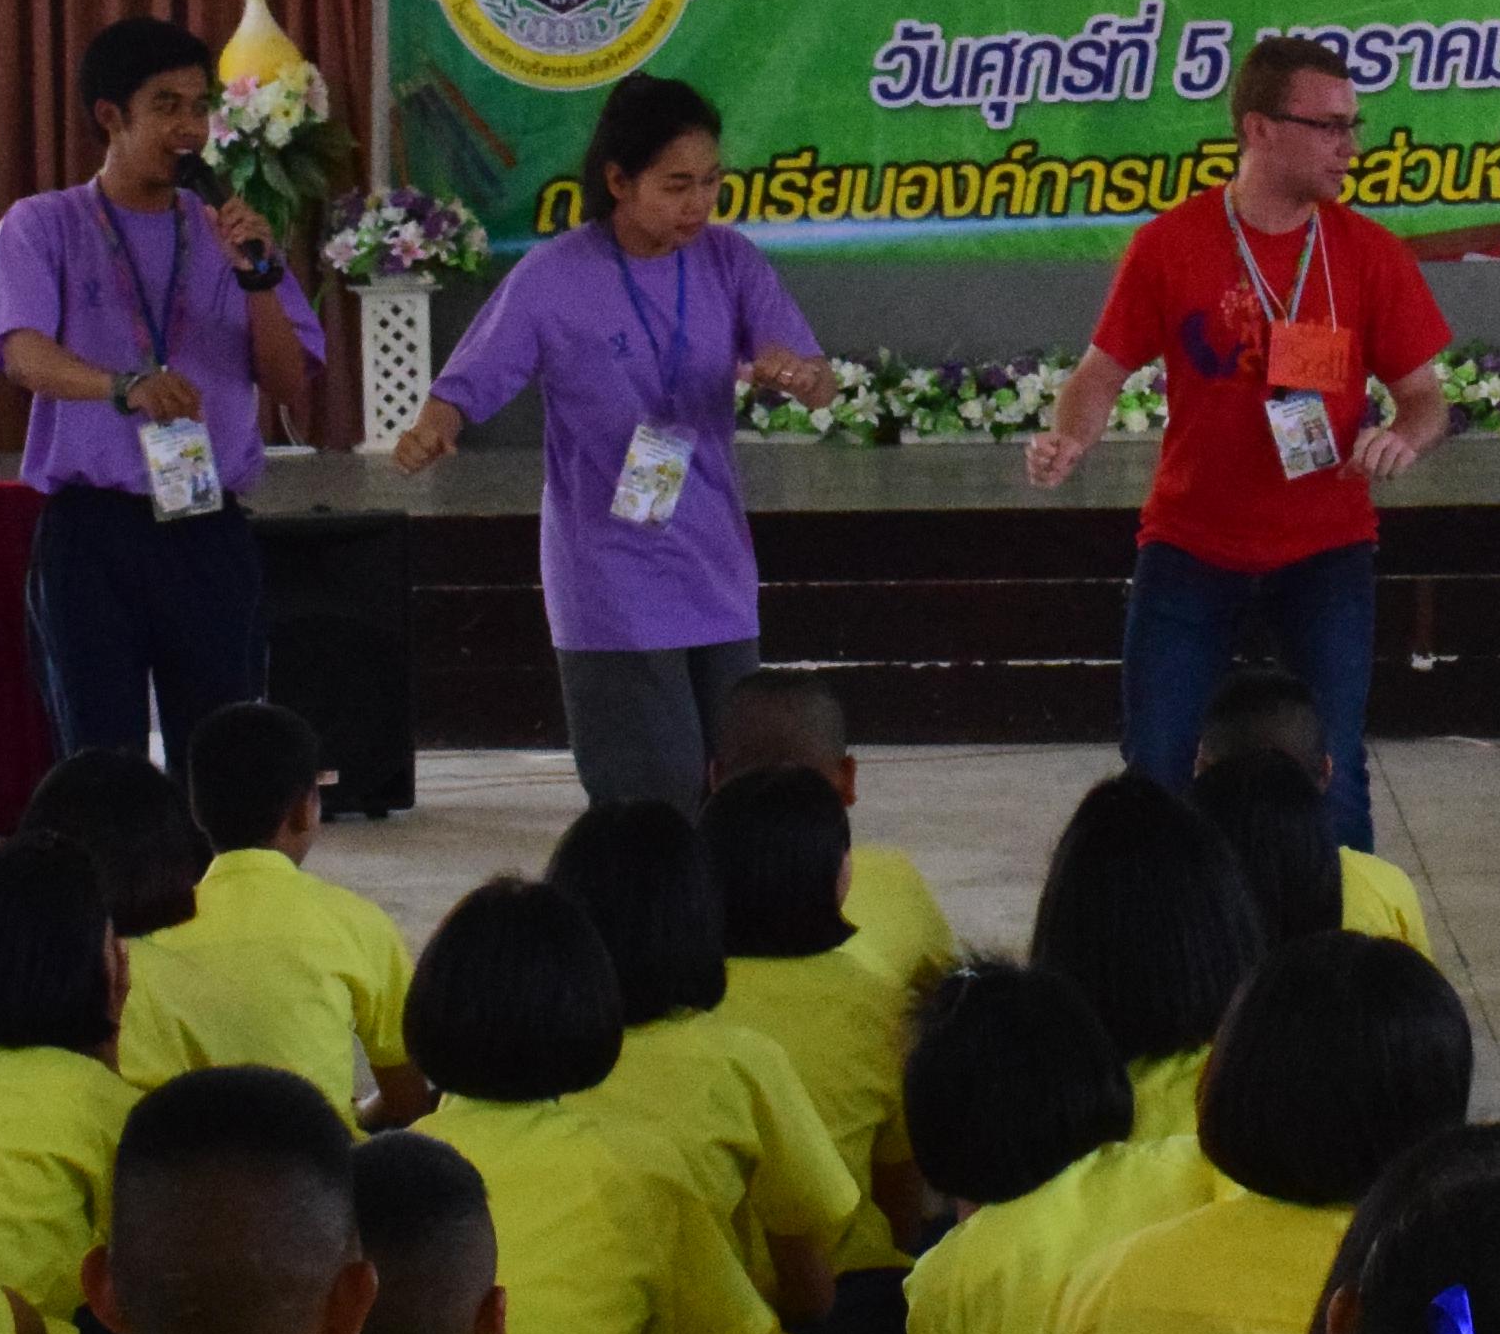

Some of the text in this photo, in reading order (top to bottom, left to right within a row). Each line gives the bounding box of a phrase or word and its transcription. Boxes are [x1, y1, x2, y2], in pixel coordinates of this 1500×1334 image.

[874, 1, 1161, 126] วันศุกร์ที่
[1176, 22, 1231, 100] 5
